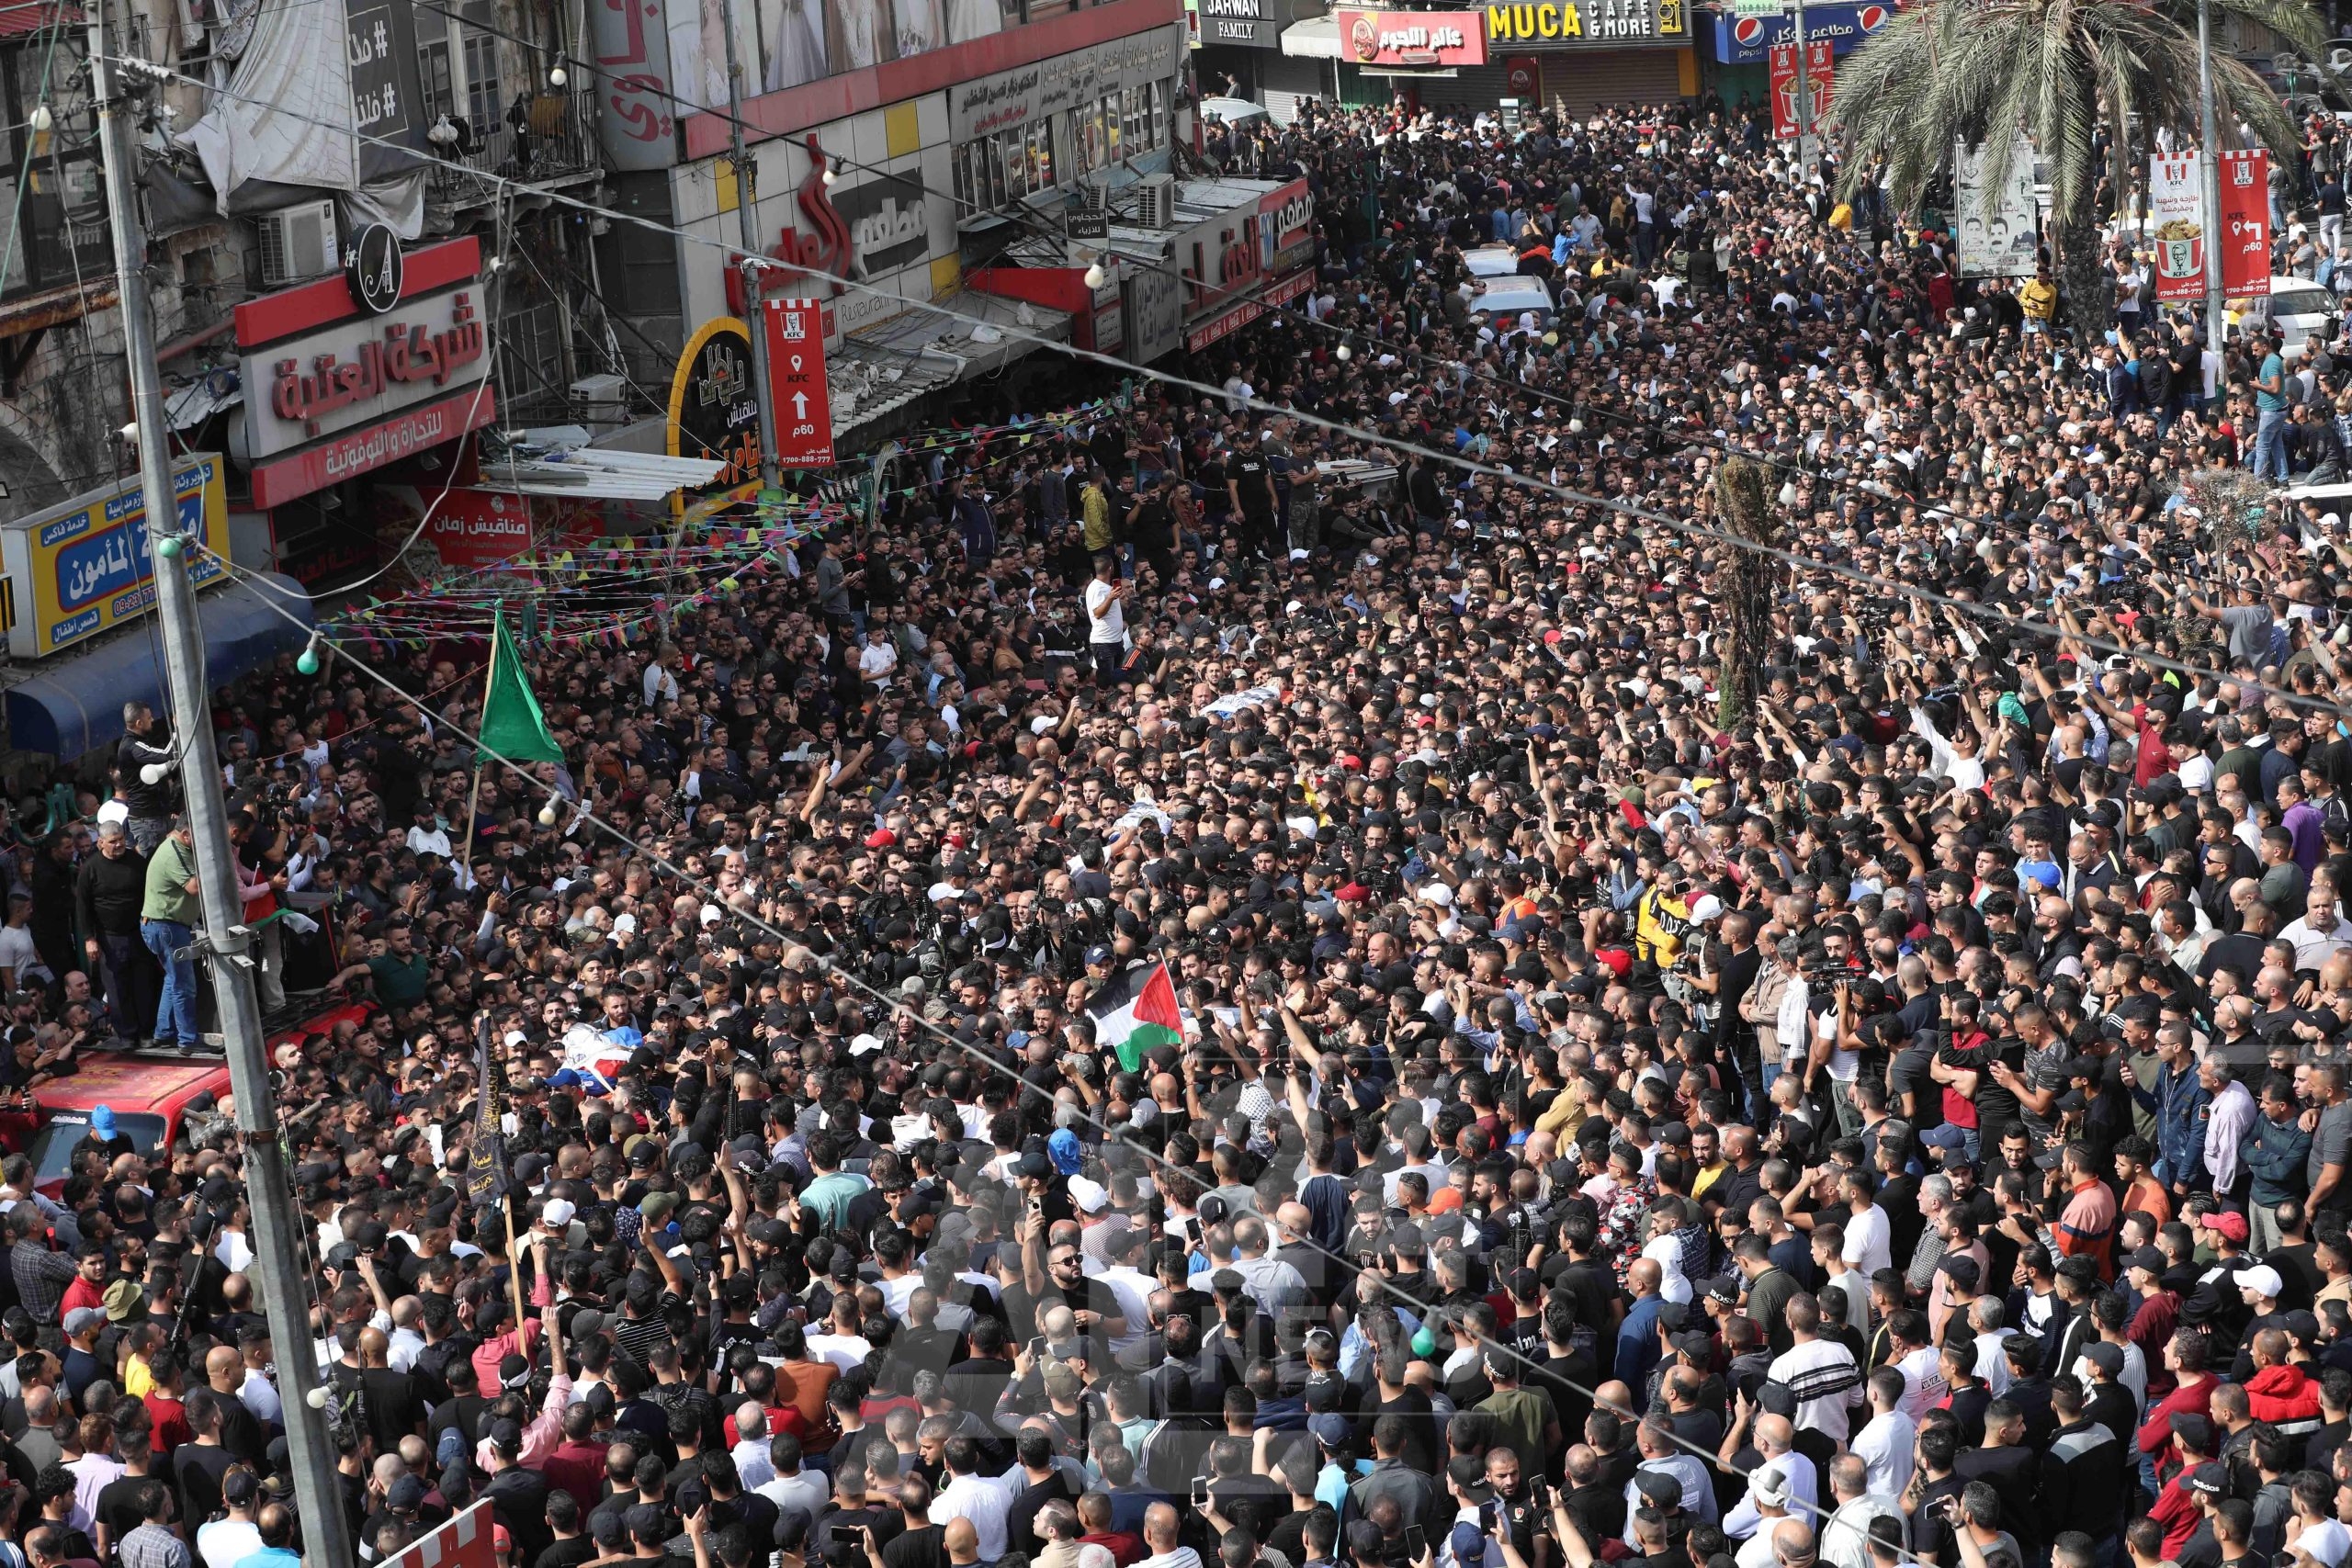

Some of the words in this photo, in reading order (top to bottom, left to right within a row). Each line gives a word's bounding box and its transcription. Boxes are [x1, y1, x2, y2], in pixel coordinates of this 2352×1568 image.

[1208, 0, 1260, 17] JARWAN
[1488, 3, 1581, 39] MUCA
[1218, 22, 1252, 39] FAMILY
[1379, 27, 1428, 51] اللحوم
[1430, 27, 1463, 51] عالم
[1811, 25, 1853, 39] مطاعم
[1738, 49, 1762, 58] pepsi
[1068, 212, 1104, 223] الحجاوي
[1278, 194, 1313, 250] مطعم
[2227, 212, 2246, 220] KFC
[384, 292, 483, 386] شركة
[787, 374, 810, 383] KFC
[435, 515, 465, 536] زمان
[469, 515, 526, 536] مناقيش
[1709, 1288, 1736, 1304] BOSS
[2192, 1478, 2220, 1493] adidas
